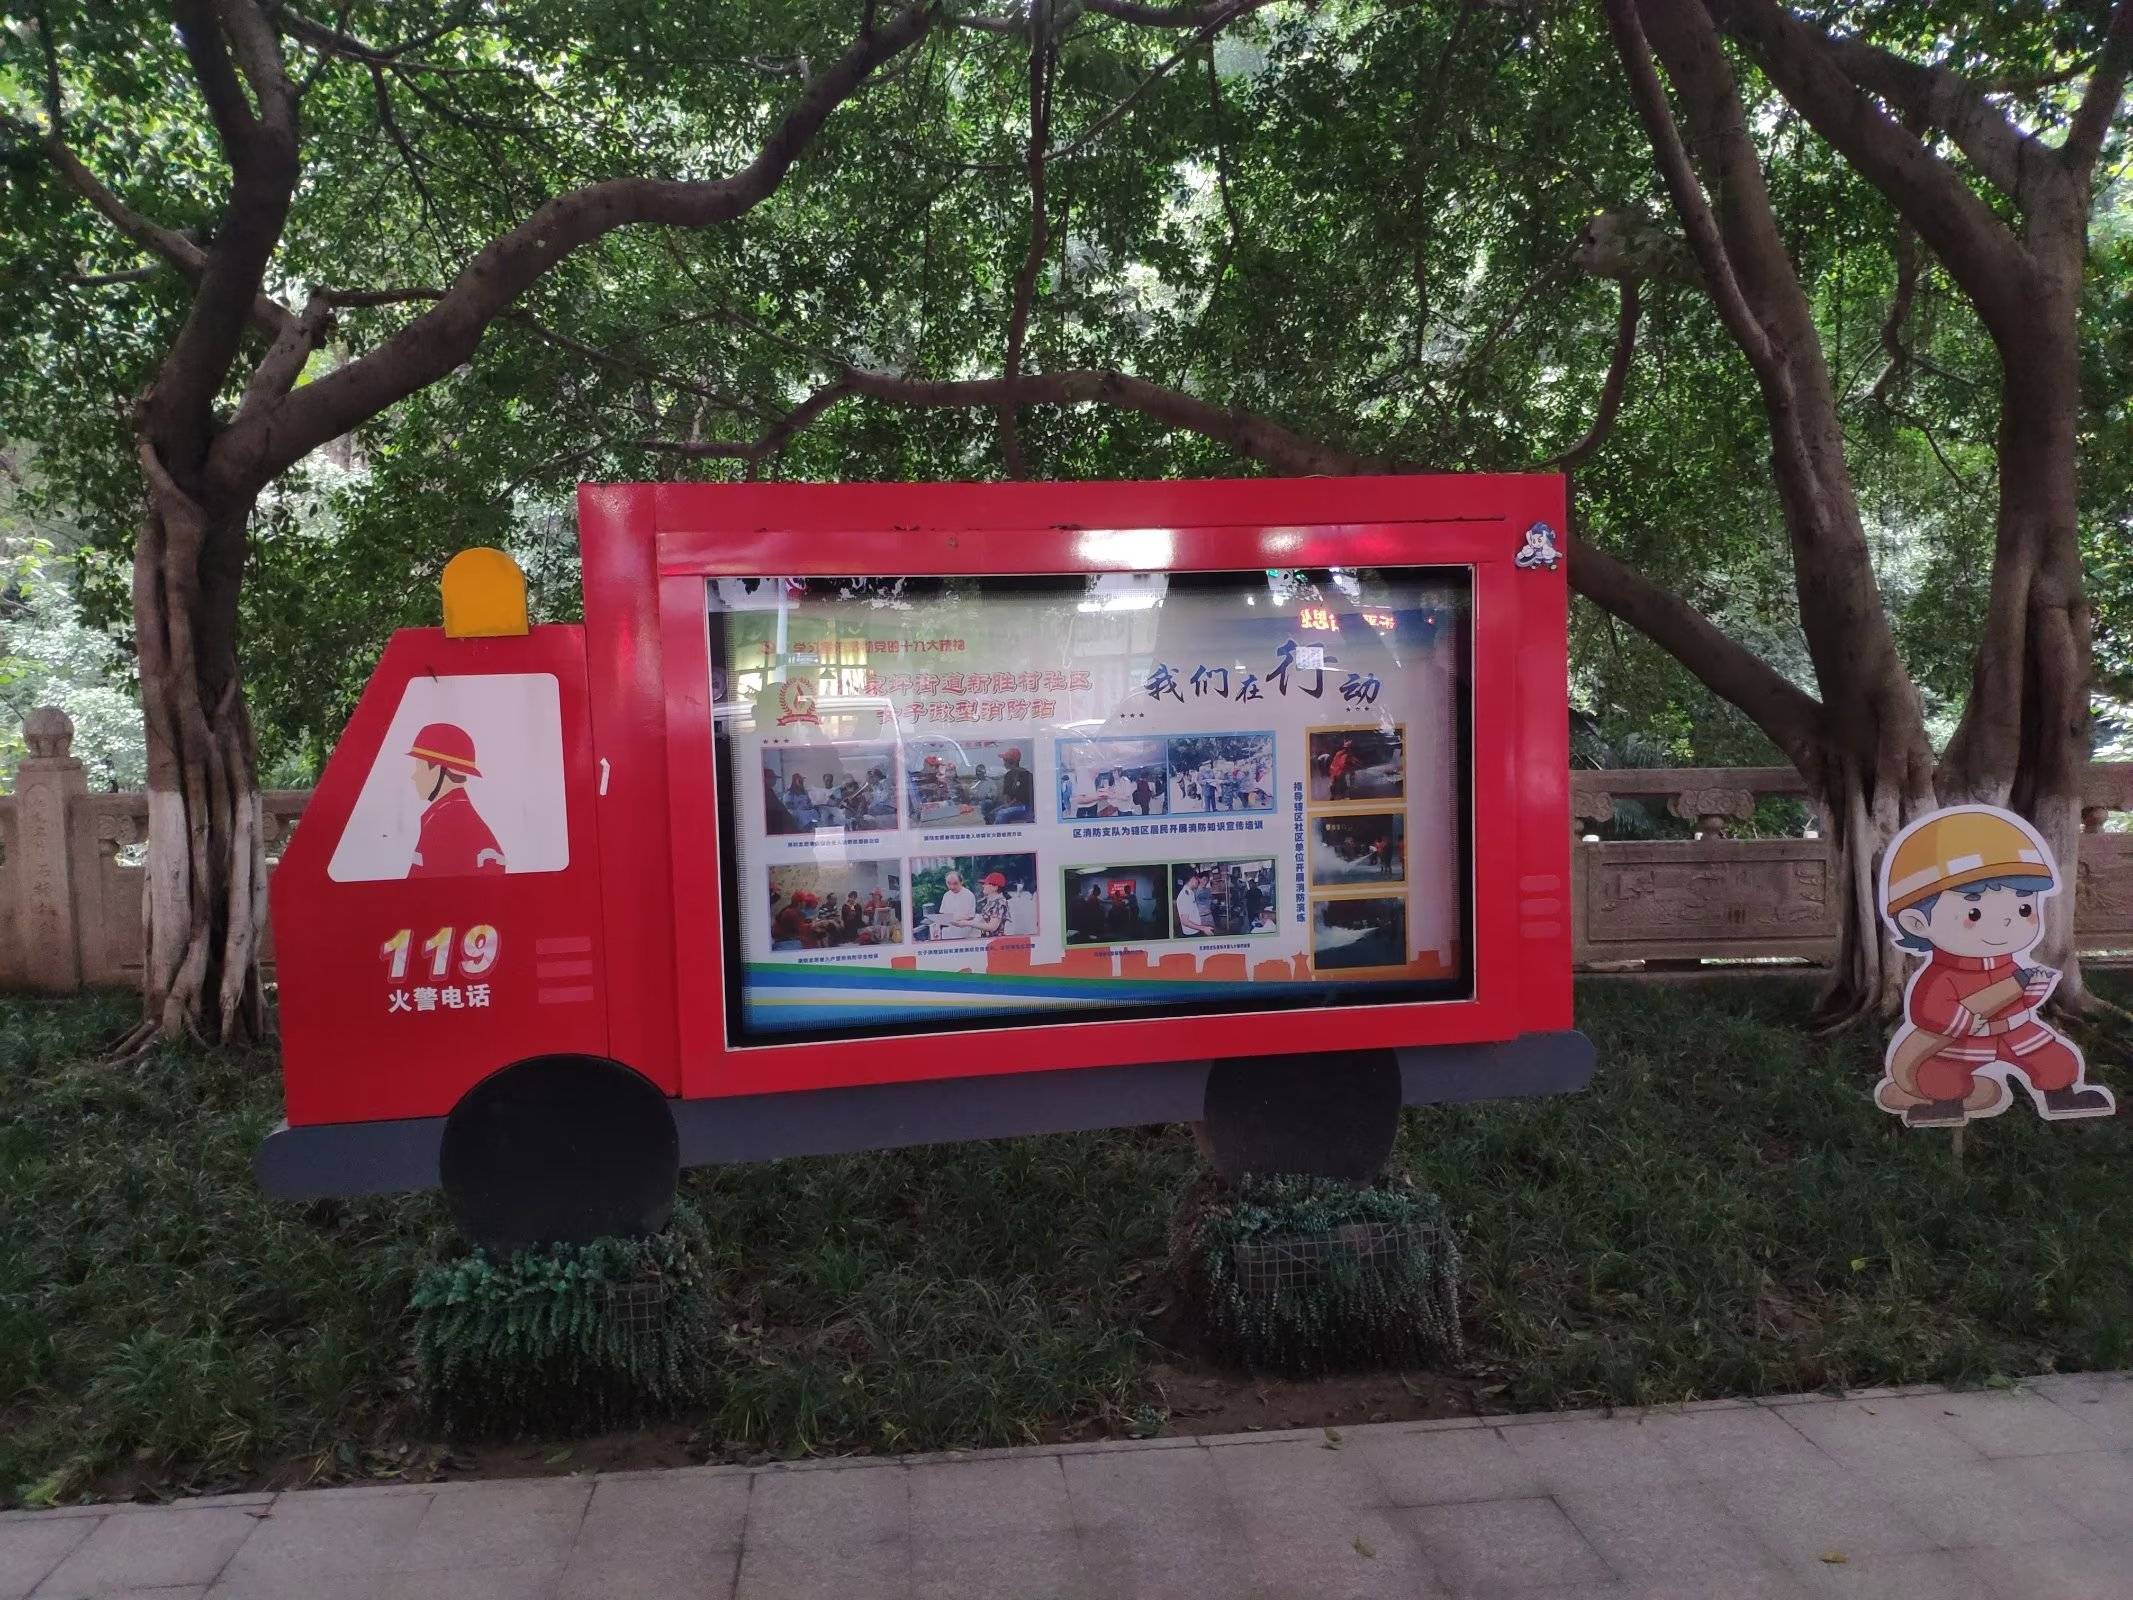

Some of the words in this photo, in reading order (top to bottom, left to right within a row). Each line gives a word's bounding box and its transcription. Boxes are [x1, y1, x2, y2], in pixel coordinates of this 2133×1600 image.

[842, 669, 1094, 697] 家坪街道新胜村社区
[1143, 638, 1382, 705] 我们在行动
[1072, 820, 1264, 838] 区消防支队为辖区居民开展消防知识宣传培训
[1293, 781, 1306, 923] 指导辖区社区单位开展消防演练
[380, 923, 501, 983] 119
[388, 983, 491, 1013] 火警电话
